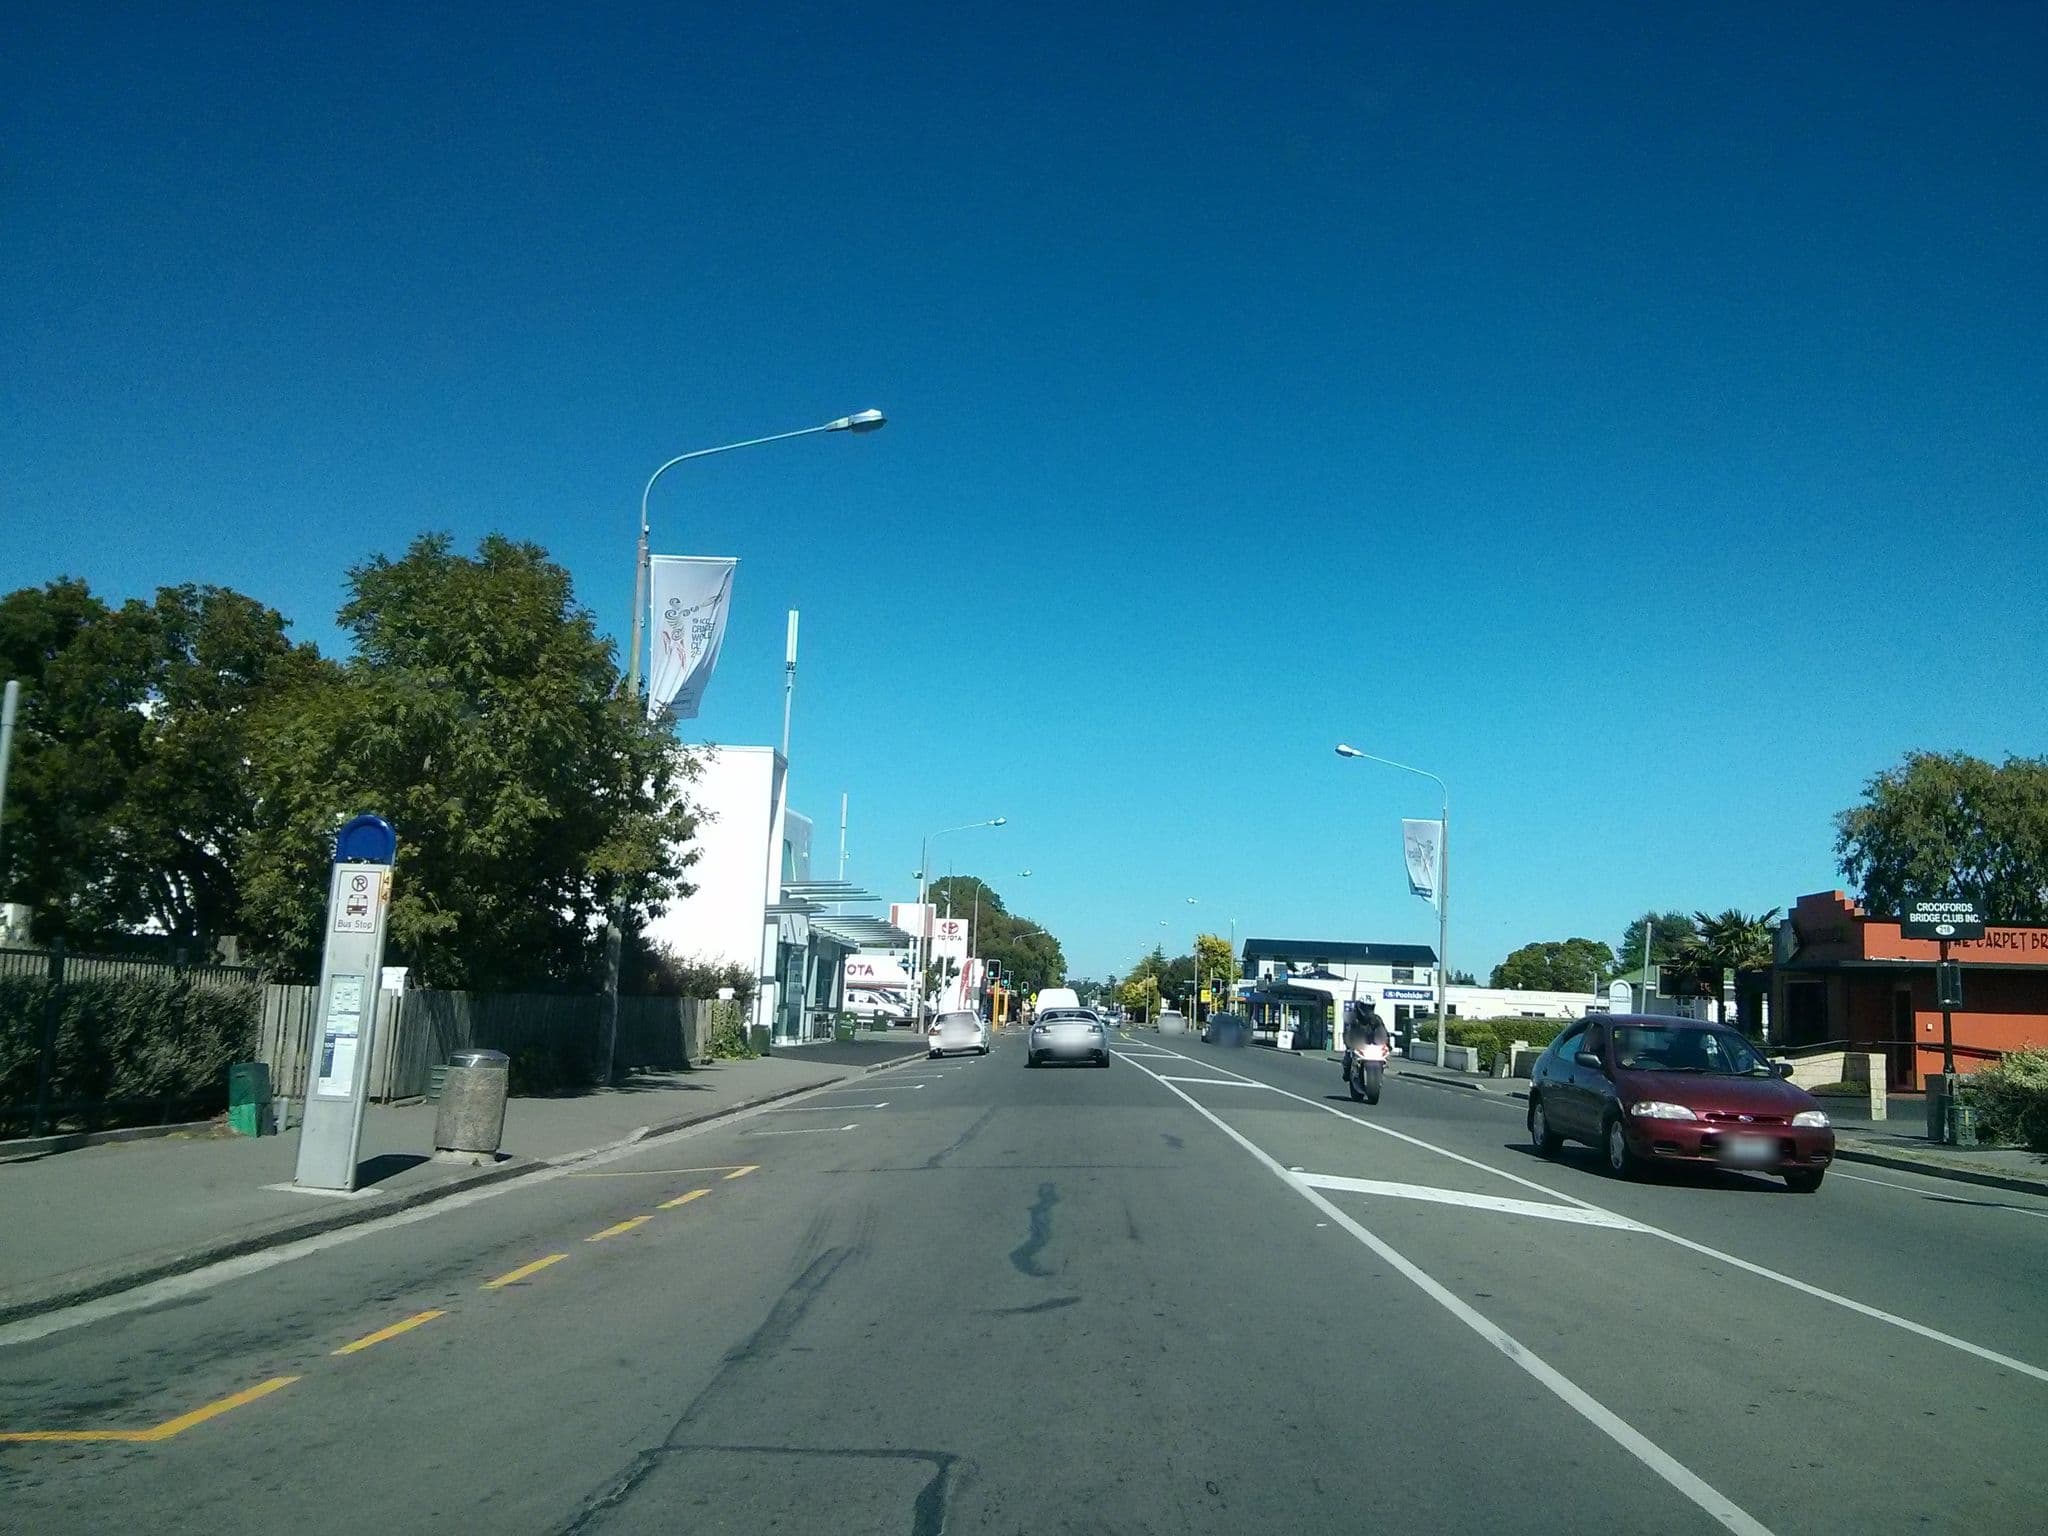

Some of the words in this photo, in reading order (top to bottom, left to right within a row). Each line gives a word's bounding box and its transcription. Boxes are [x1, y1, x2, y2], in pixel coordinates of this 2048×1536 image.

[1916, 902, 1974, 912] CROCKFORDS
[1909, 913, 1941, 923] BRIDGE
[1941, 913, 1964, 923] CLUB
[1965, 914, 1981, 924] INC.
[337, 919, 352, 928] Bus
[354, 919, 373, 930] Stop
[1976, 932, 2028, 951] CARPET
[1395, 991, 1423, 999] Poolside
